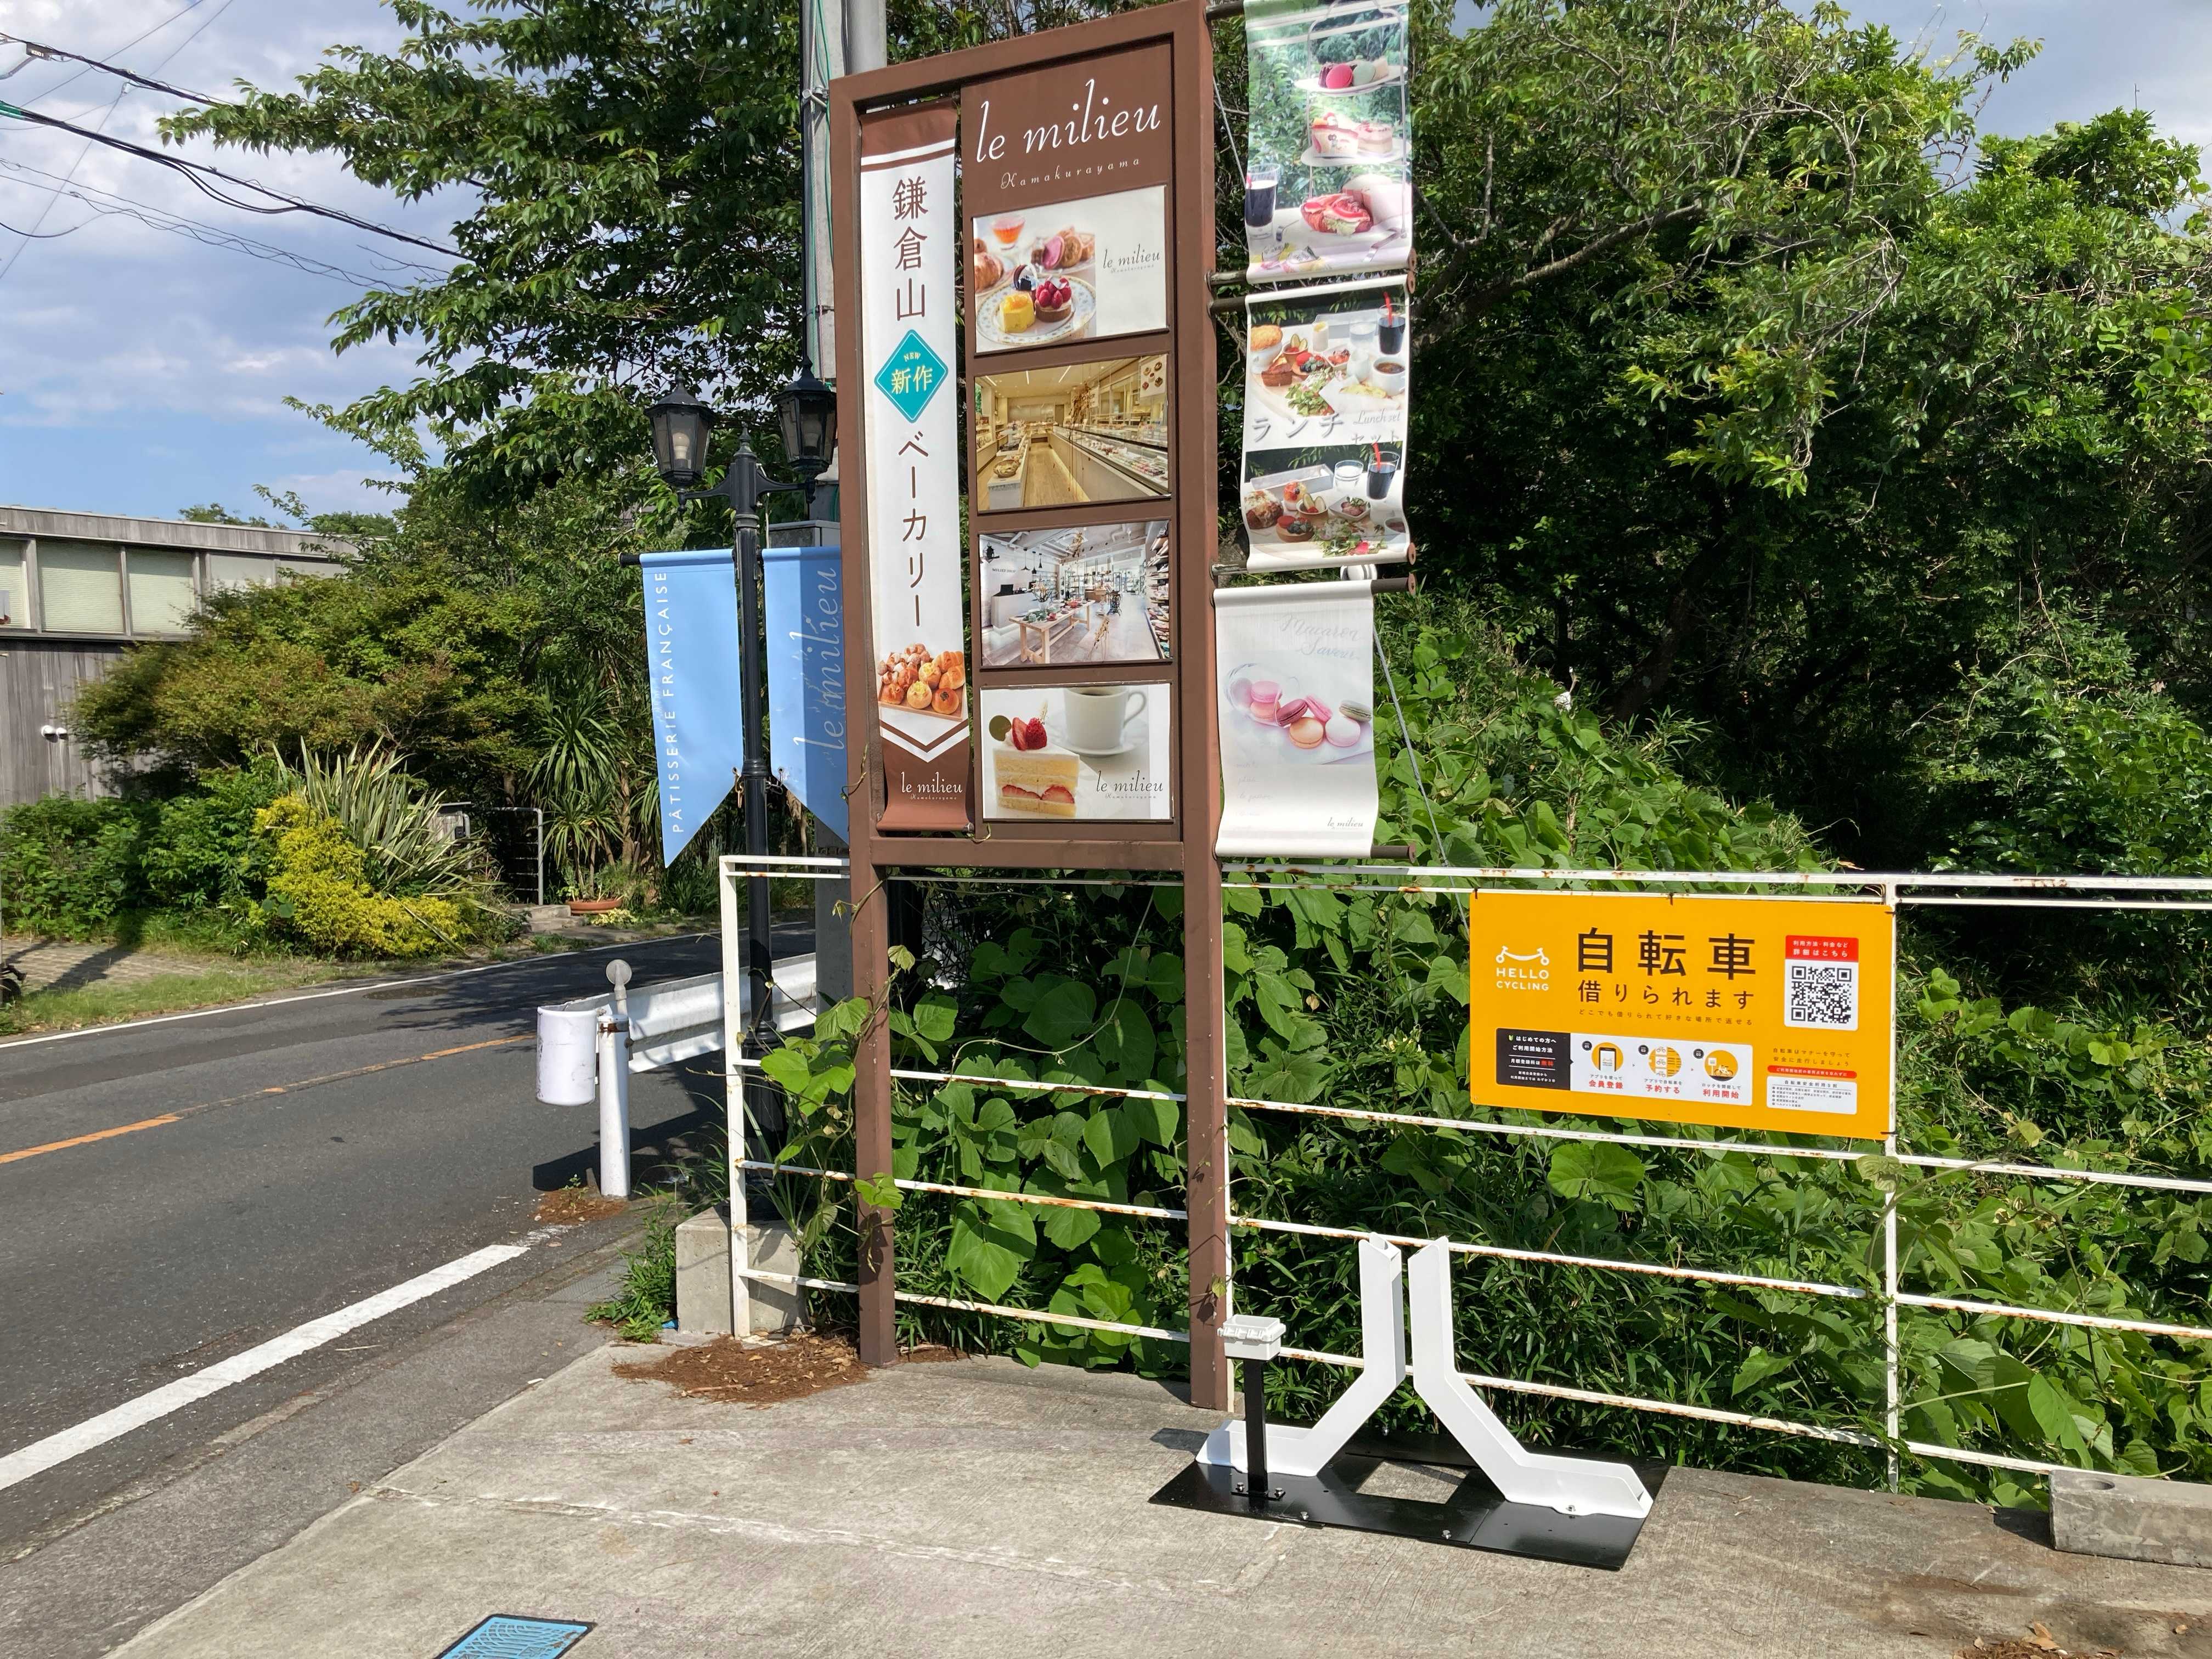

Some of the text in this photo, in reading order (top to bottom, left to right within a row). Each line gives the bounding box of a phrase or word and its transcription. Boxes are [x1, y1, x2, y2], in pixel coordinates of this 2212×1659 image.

[976, 78, 1161, 163] le milieu
[1000, 157, 1140, 189] Kamakurayama
[892, 176, 928, 321] 鎌倉山
[1103, 243, 1160, 269] le milieu
[904, 351, 921, 362] NEW
[891, 365, 933, 394] 新作
[1251, 412, 1344, 442] ランチ
[1353, 409, 1387, 425] Lunch
[898, 431, 929, 627] ベーカリー
[789, 567, 845, 751] le milieu
[654, 572, 684, 833] PÂTISSERIE FRANÇAISE
[901, 771, 963, 793] le milieu
[1096, 770, 1164, 792] le milieu
[1327, 816, 1364, 827] le milieu
[1577, 927, 1756, 980] 自転車
[1793, 948, 1848, 957] 詳細はこちら
[1496, 967, 1549, 979] HELLO
[1496, 980, 1549, 991] CYCLING
[1577, 979, 1754, 1009] 借りられます
[1512, 1045, 1553, 1053] ご利用開始方法
[1516, 1035, 1557, 1043] はじめての方へ
[1589, 1080, 1623, 1089] 会員登録
[1645, 1084, 1680, 1094] 予約する
[1702, 1088, 1739, 1099] 利用開始
